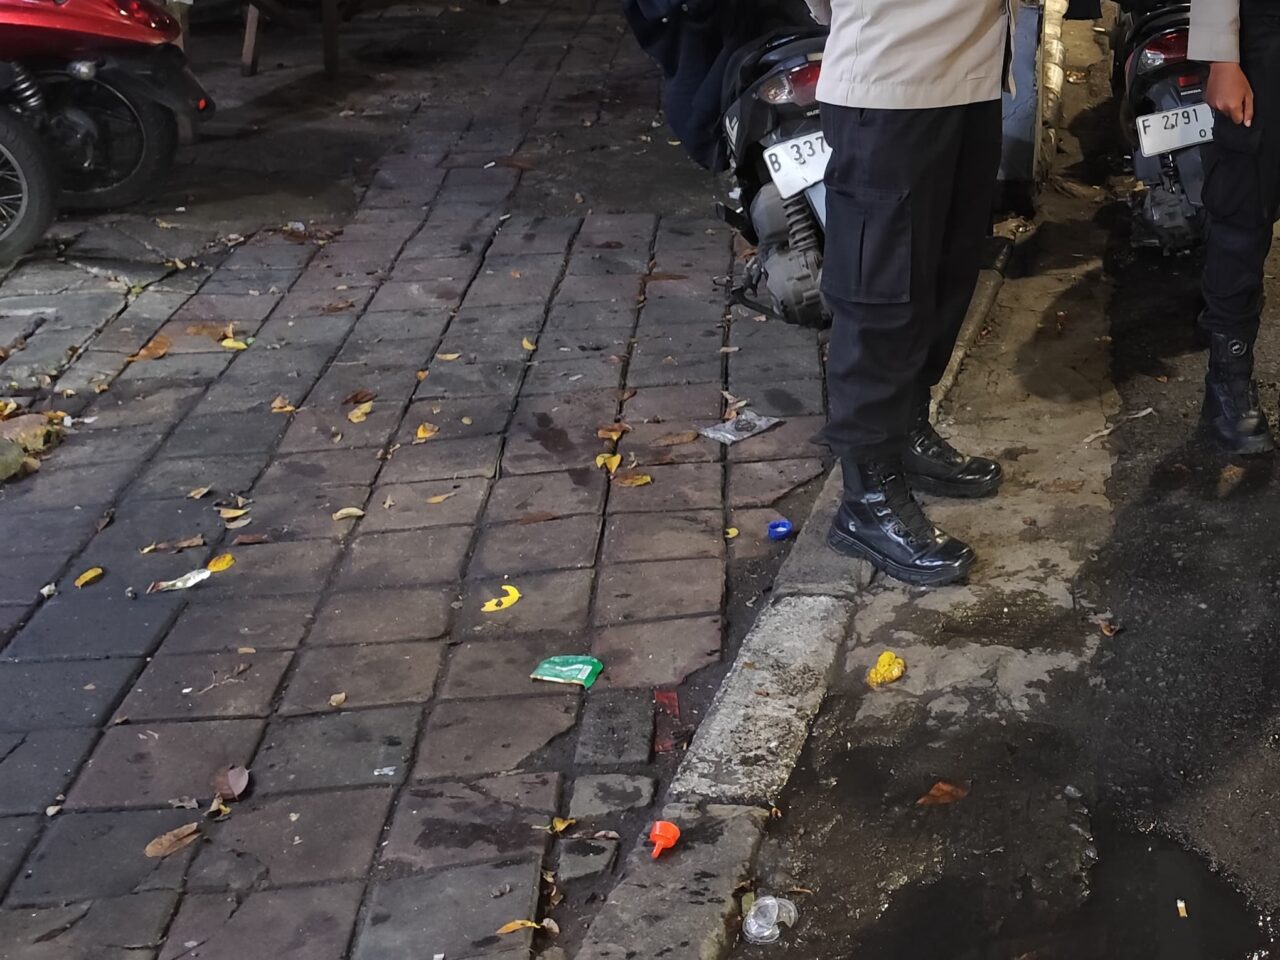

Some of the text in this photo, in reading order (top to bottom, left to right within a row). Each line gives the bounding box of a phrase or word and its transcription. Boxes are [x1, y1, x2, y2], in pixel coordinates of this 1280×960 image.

[1141, 108, 1199, 135] F 2791
[768, 135, 825, 173] B 337
